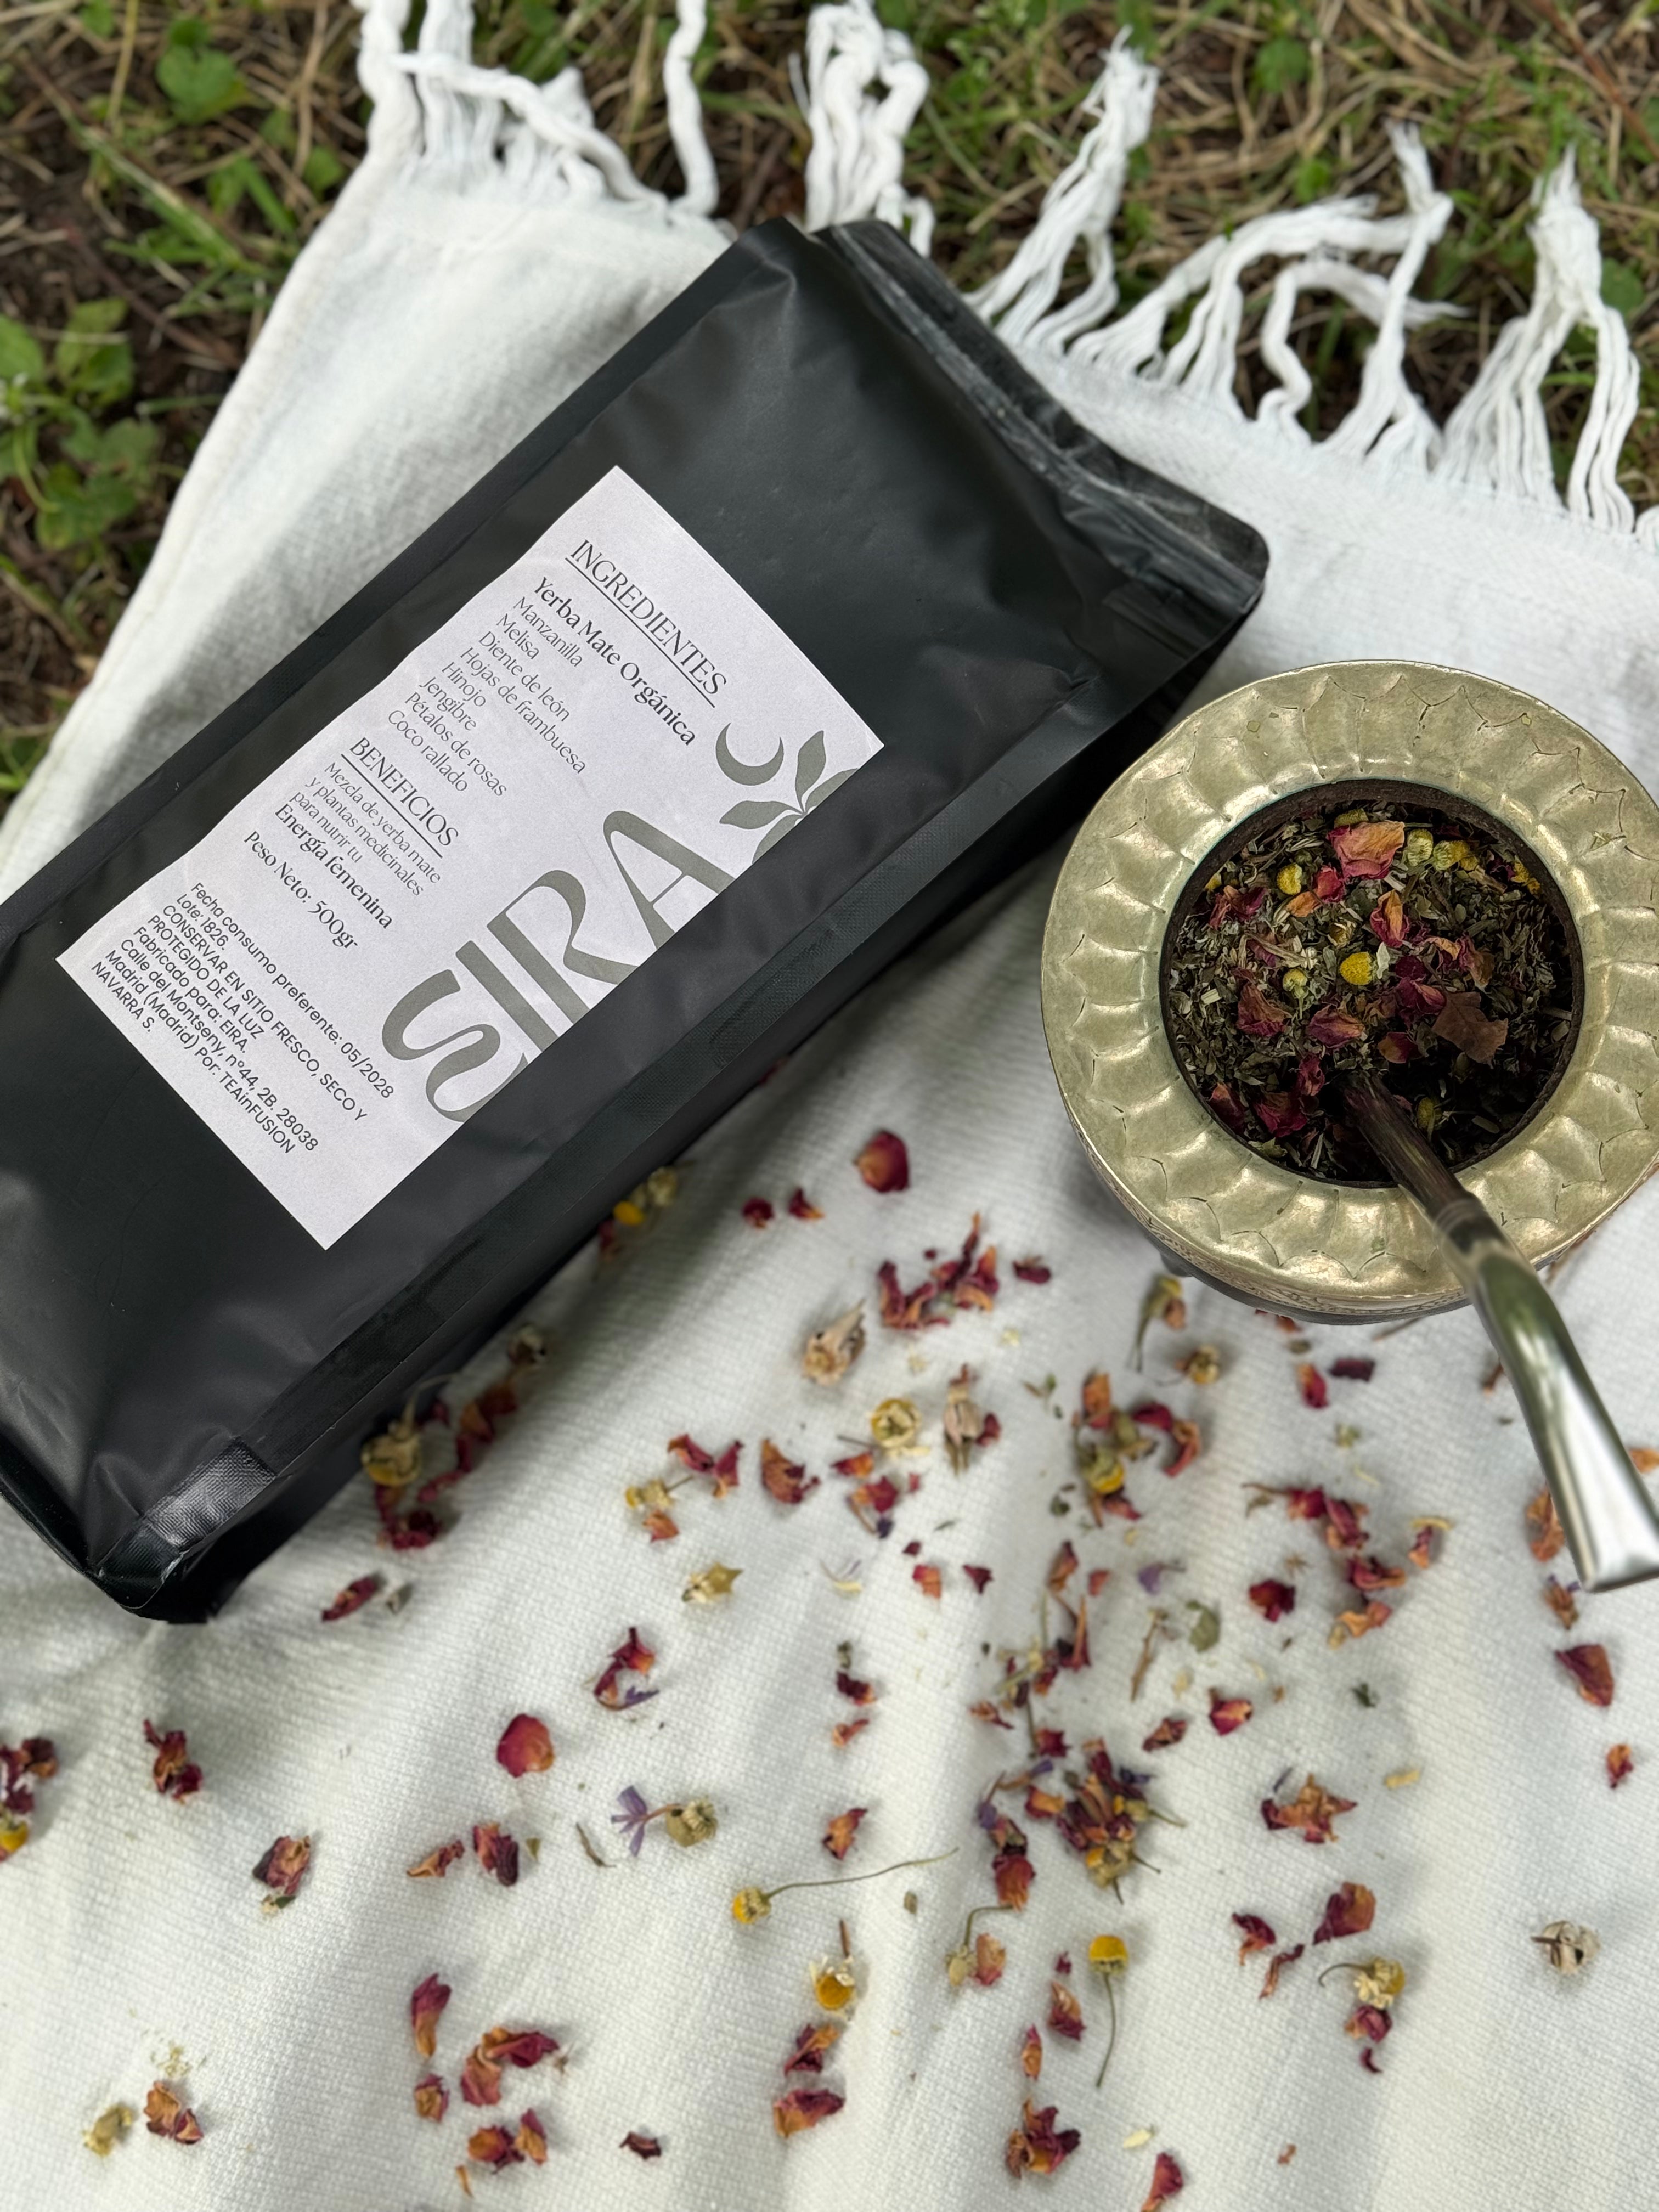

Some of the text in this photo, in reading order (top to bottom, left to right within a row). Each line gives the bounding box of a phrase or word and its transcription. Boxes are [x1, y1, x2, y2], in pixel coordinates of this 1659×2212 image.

[478, 630, 569, 722] Diente de león
[495, 612, 539, 660] Melisa
[512, 595, 583, 668] Manzanilla
[533, 575, 696, 746] Yerba Mate Orgánica
[569, 538, 727, 695] INGREDIENTES
[418, 675, 476, 731] Jengibre
[441, 661, 486, 707] Hinojo
[460, 646, 585, 774] Hojas de frambuesa
[348, 736, 459, 846] BENEFICIOS
[387, 709, 467, 792] Coco rallado
[404, 691, 507, 797] Pétalos de rosas
[274, 803, 393, 929] Energía femenina
[288, 791, 363, 864] para nutrir tu
[304, 776, 424, 896] y plantas medicinales
[323, 761, 441, 883] Mezcla de yerba mate
[176, 893, 229, 951] Lote: 1826.
[243, 830, 358, 949] Peso Neto: 500gr
[90, 960, 155, 1032] NAVARRA S.
[132, 926, 248, 1054] Fabricado para: EIRA.
[146, 914, 265, 1040] PROTEGIDO DE LA LUZ
[162, 904, 368, 1121] CONSERVAR EN SITIO FRESCO, SECO Y
[190, 882, 394, 1098] Fecha consumo preferente: 05/2028
[104, 949, 296, 1154] Madrid (Madrid) Por: TEAinFUSION
[120, 939, 150, 972] Calle
[148, 970, 172, 992] del
[165, 988, 227, 1057] Montseny,
[256, 1086, 278, 1111] 2B.
[275, 1107, 319, 1151] 28038
